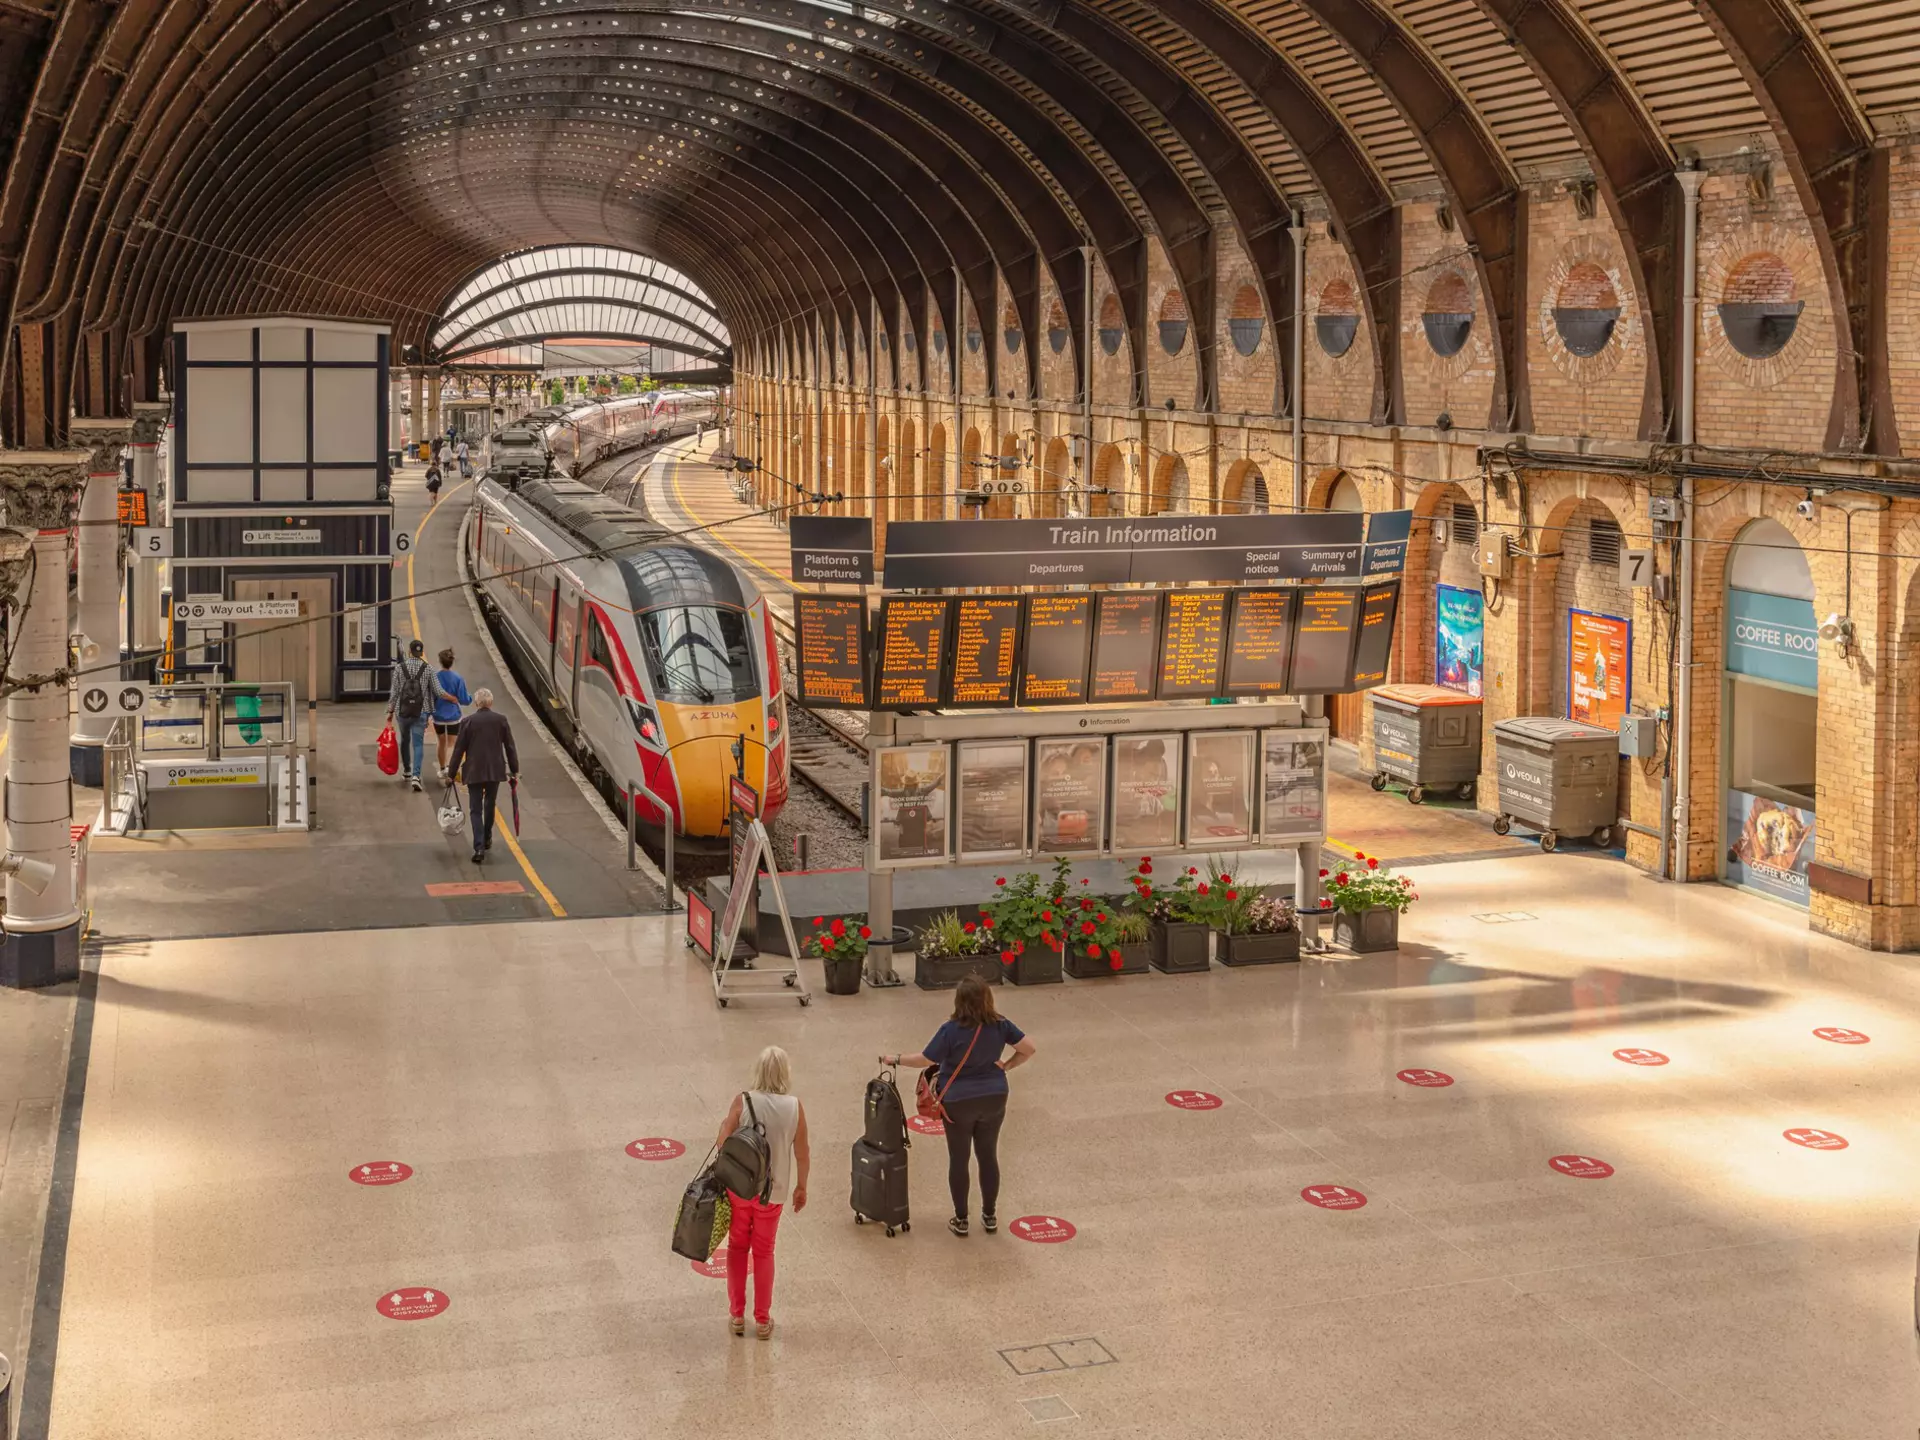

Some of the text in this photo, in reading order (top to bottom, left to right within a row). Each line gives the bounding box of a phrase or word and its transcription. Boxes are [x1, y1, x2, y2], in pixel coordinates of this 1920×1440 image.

[258, 532, 271, 540] Lift
[1049, 524, 1217, 544] Train Information
[149, 536, 161, 551] 5
[396, 533, 410, 551] 6
[1246, 552, 1281, 563] Special
[1301, 549, 1357, 561] Summary of
[1373, 547, 1397, 557] Platform
[804, 554, 859, 566] Platform 6
[1370, 560, 1400, 571] Departures
[803, 567, 862, 579] Departures
[1029, 564, 1084, 575] Departures
[1245, 564, 1280, 574] notices
[1310, 563, 1346, 572] Arrivals
[1629, 555, 1645, 581] 7
[210, 605, 253, 615] Way out
[1735, 624, 1781, 646] COFFEE
[1574, 671, 1588, 684] This
[1574, 693, 1590, 710] Body
[690, 711, 739, 721] AZUMA
[1389, 728, 1408, 740] VEOLIA
[1515, 769, 1542, 785] VEOLIA
[1751, 861, 1779, 878] COFFEE
[1780, 871, 1805, 888] ROOM
[393, 1308, 436, 1316] DISTANCE
